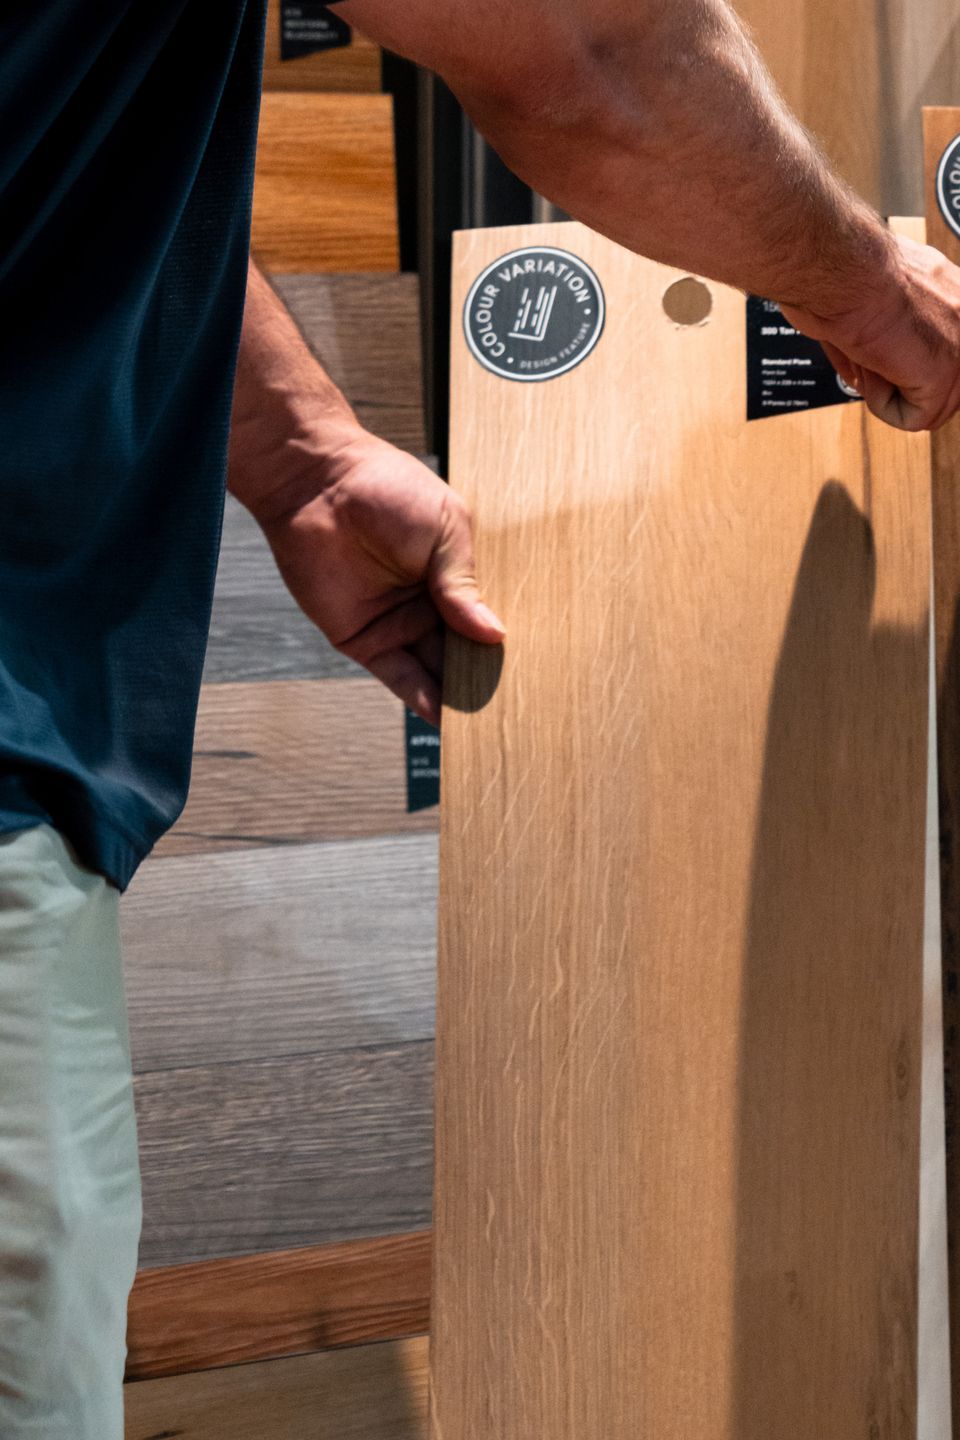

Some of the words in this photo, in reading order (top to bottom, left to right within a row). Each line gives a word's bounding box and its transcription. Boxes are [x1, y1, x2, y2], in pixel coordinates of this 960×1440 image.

[475, 283, 506, 358] COLOUR
[497, 258, 592, 304] VARIATION
[518, 356, 559, 370] DESIGN
[558, 322, 592, 359] FEATURE
